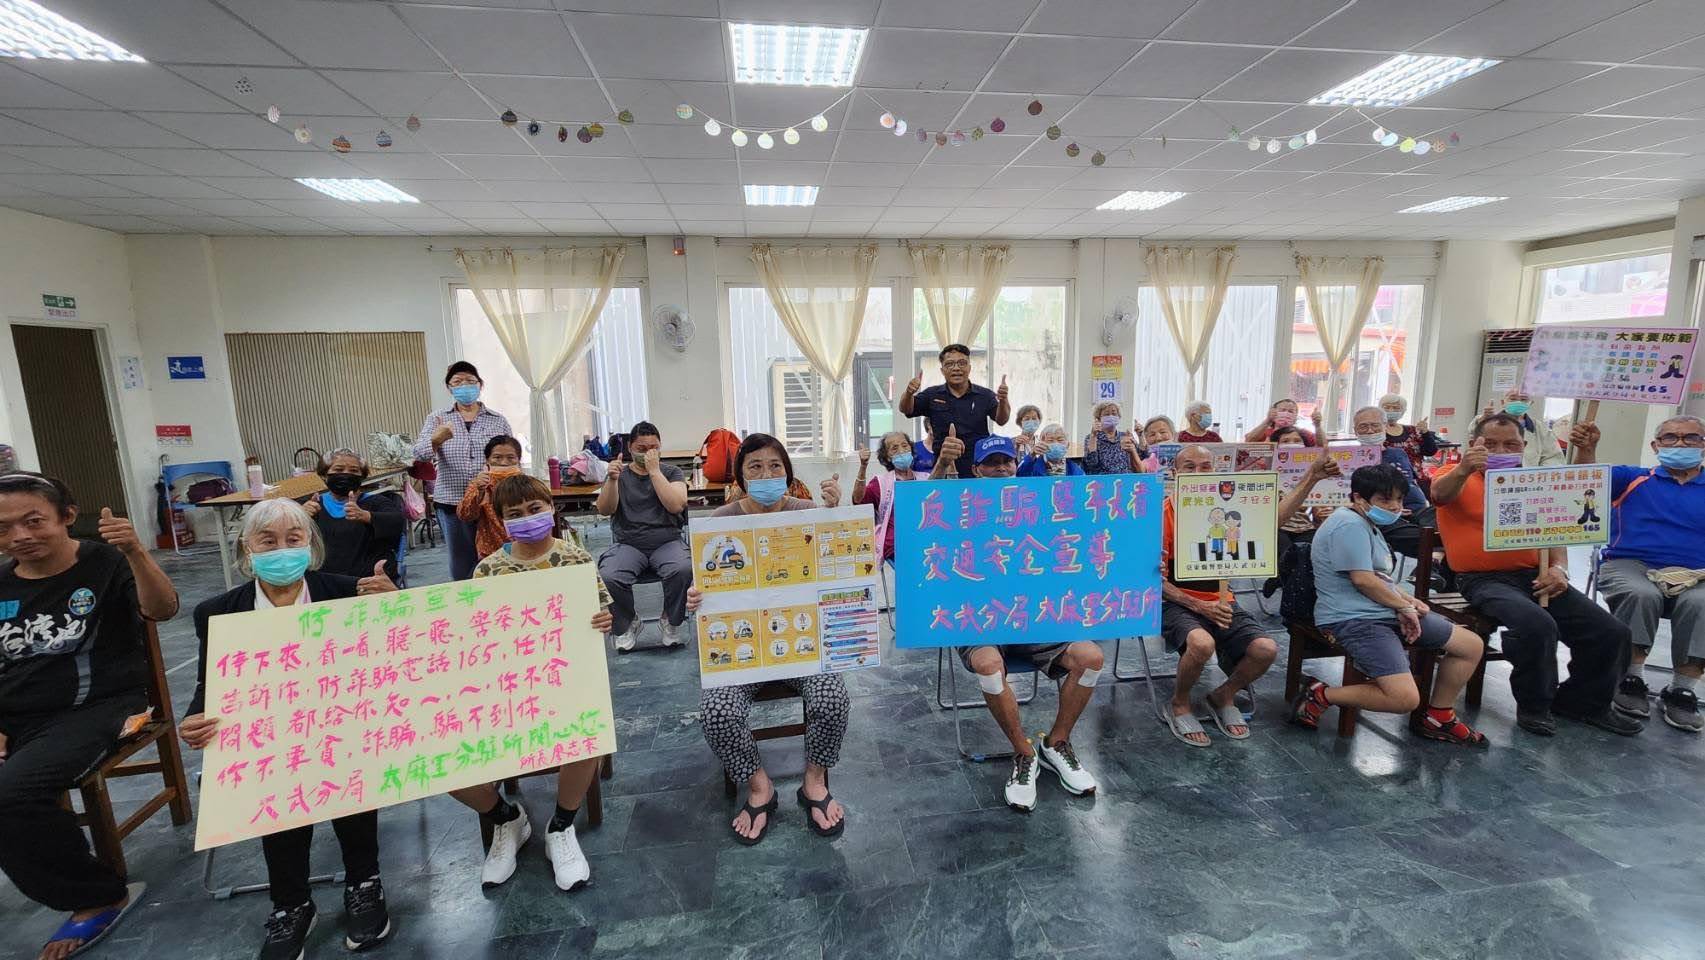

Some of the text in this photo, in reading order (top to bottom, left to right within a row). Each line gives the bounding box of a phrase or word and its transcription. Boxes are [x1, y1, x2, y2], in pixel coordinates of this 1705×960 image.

[1615, 332, 1693, 344] 大家要防範
[1101, 381, 1115, 398] 29
[1238, 483, 1275, 492] 夜間出門
[1583, 524, 1601, 533] 165
